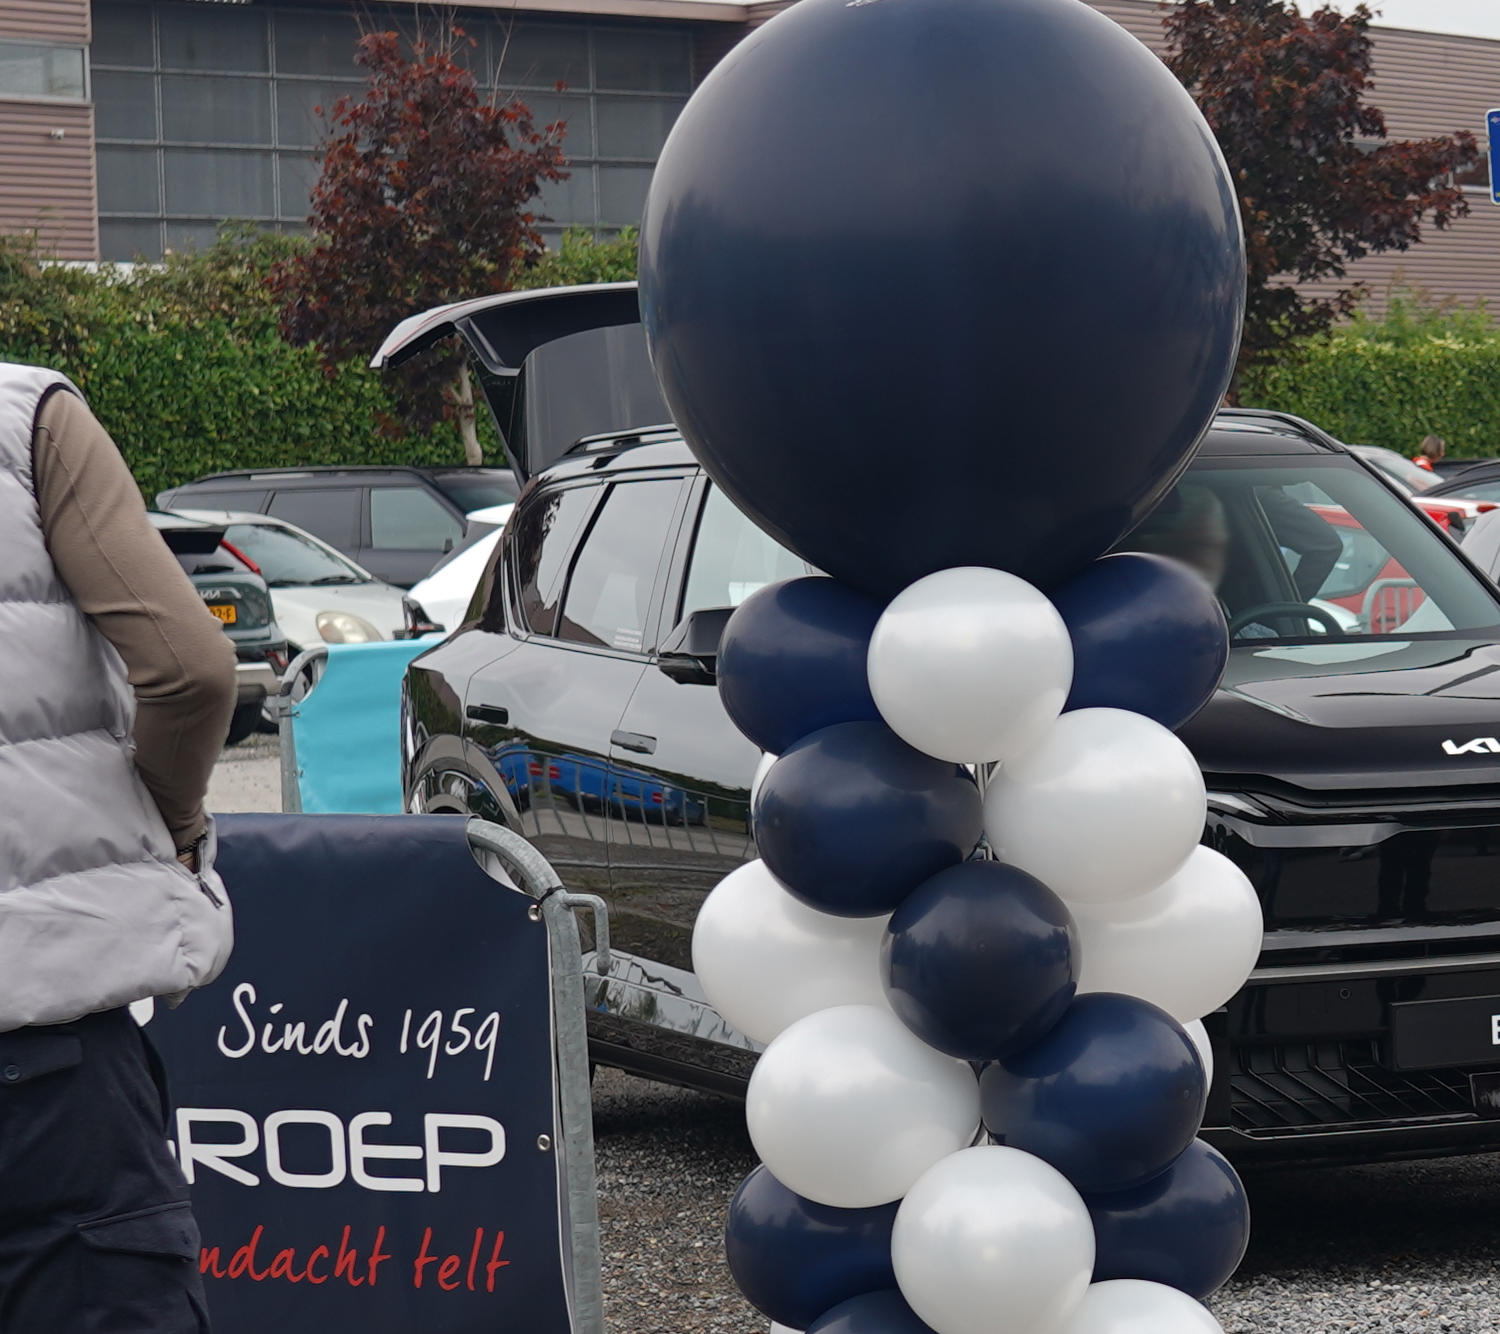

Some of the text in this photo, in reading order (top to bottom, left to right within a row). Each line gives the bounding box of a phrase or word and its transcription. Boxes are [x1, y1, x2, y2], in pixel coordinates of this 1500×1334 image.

[217, 982, 501, 1082] Sinds 1959
[169, 1107, 507, 1193] ROEP
[413, 1226, 512, 1293] telt
